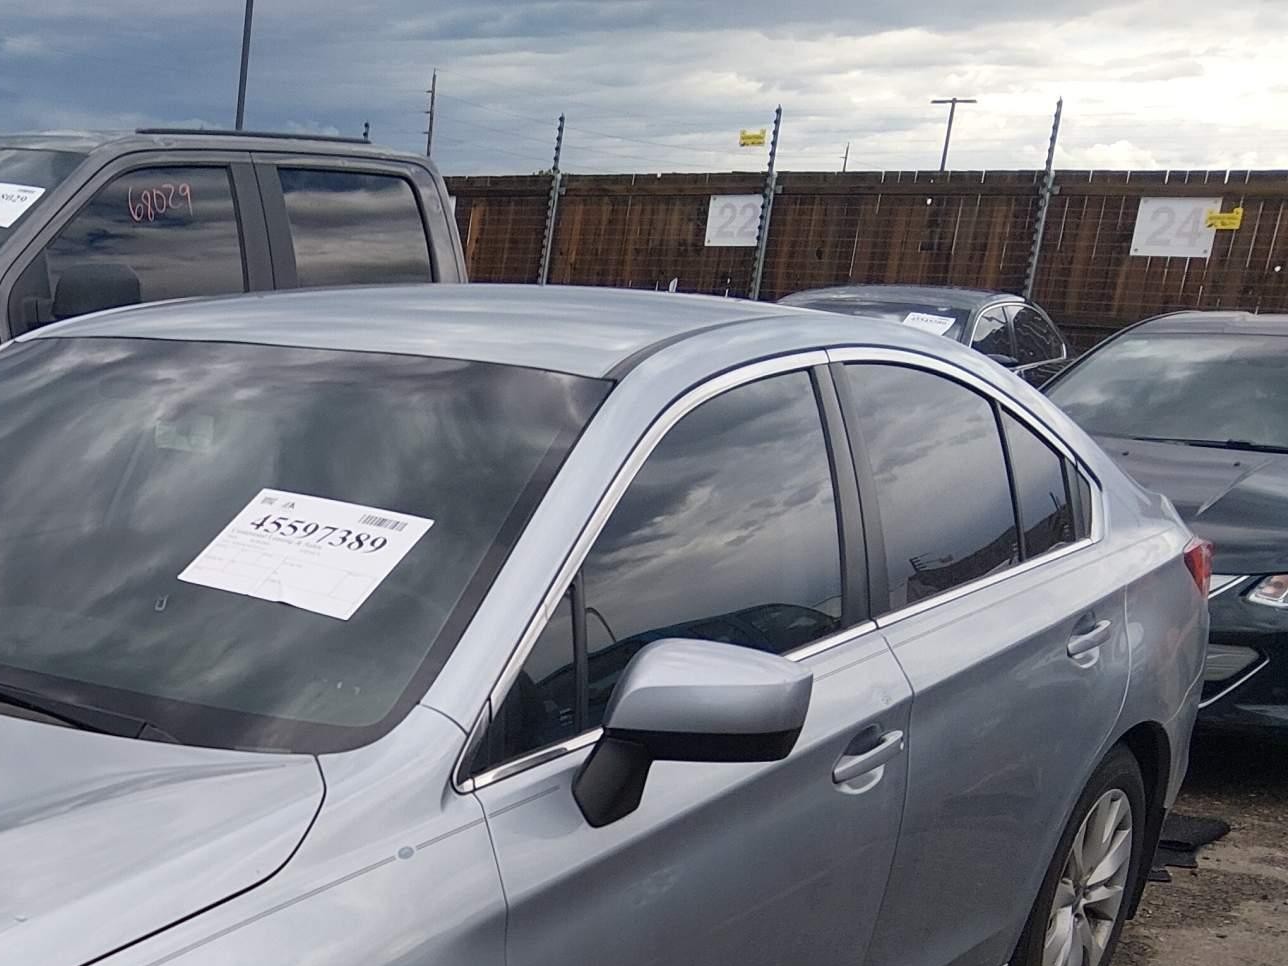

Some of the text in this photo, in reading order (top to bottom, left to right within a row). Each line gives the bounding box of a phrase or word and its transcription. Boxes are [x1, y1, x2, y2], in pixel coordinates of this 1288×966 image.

[127, 183, 193, 222] 68029
[716, 203, 760, 238] 22
[1145, 206, 1204, 248] 24
[250, 513, 388, 554] 45597389
